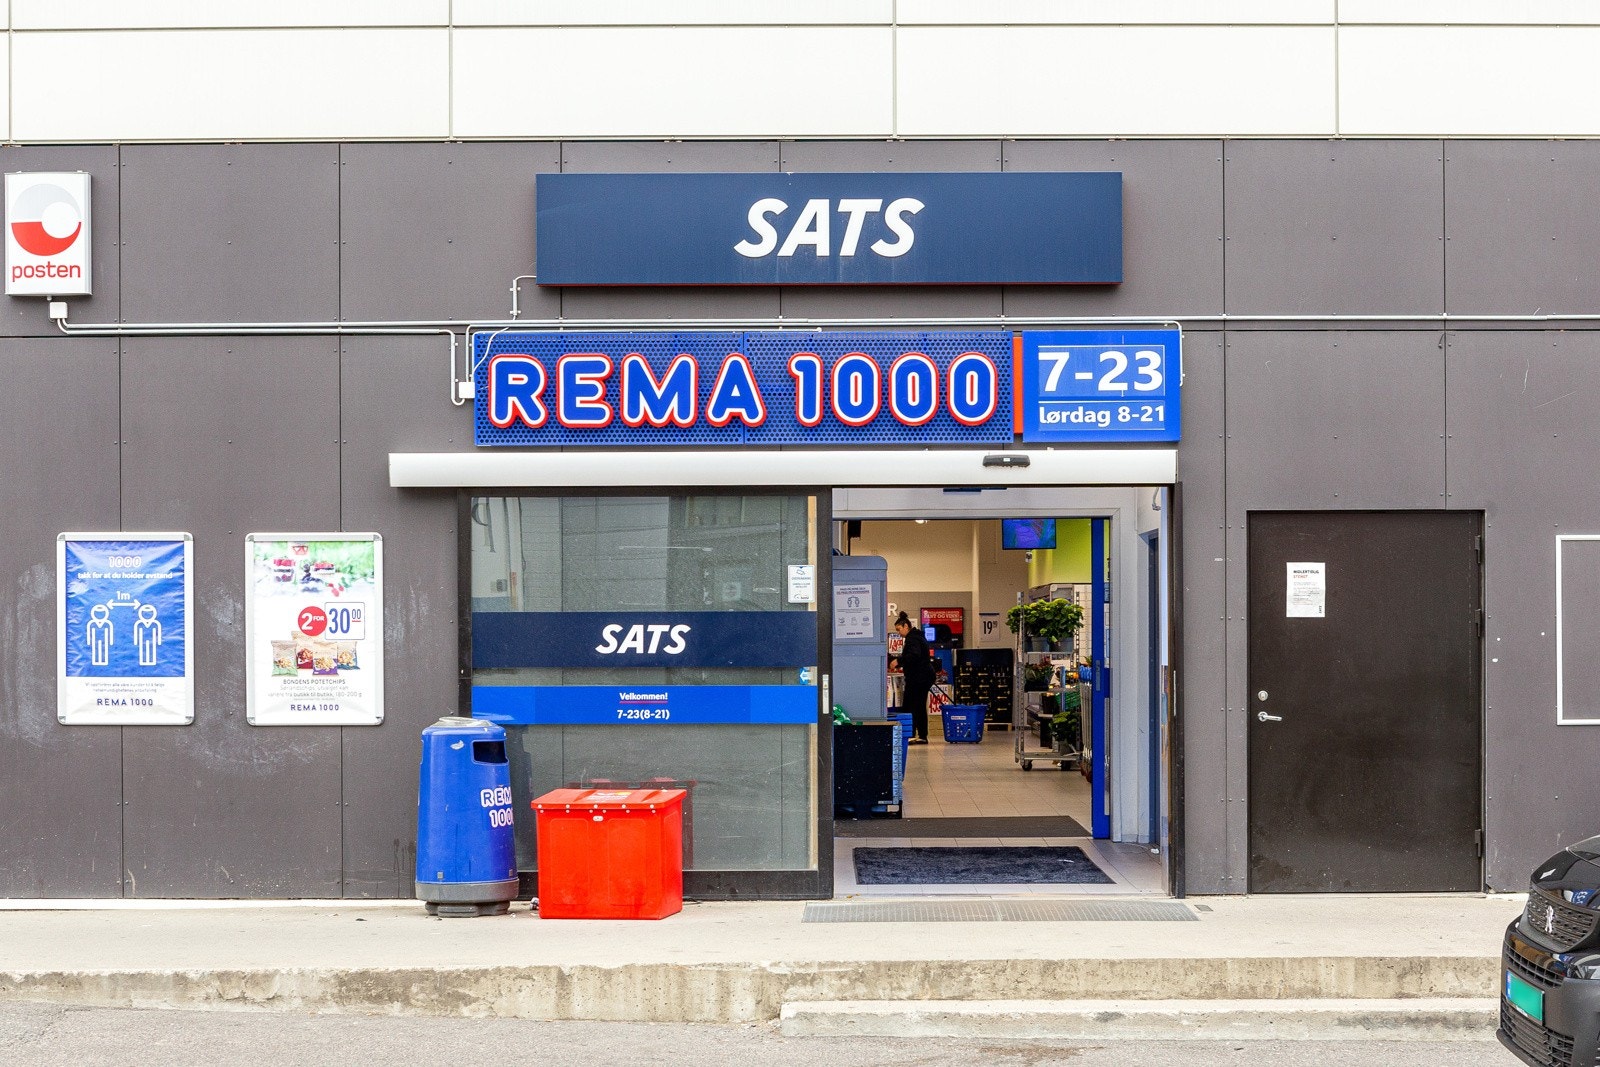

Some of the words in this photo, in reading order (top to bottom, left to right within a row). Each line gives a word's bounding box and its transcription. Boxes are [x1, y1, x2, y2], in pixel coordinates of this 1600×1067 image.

[733, 197, 926, 258] SATS
[12, 261, 81, 282] posten
[1038, 350, 1163, 392] 7-23
[488, 352, 767, 428] REMA
[787, 352, 999, 428] 1000
[1039, 405, 1111, 428] lørdag
[1117, 405, 1164, 423] 8-21
[108, 555, 142, 568] 1000
[92, 571, 103, 579] for
[103, 571, 111, 579] at
[111, 571, 122, 579] du
[122, 571, 144, 579] holder
[116, 591, 131, 600] 1m
[301, 612, 313, 631] 2
[328, 608, 351, 634] 30
[351, 608, 362, 620] 00
[983, 620, 993, 634] 19
[595, 624, 692, 655] SATS
[97, 698, 128, 706] REMA
[130, 698, 154, 706] 1000
[619, 692, 668, 700] Velkommen!
[617, 709, 670, 720] 7-23(8-21)
